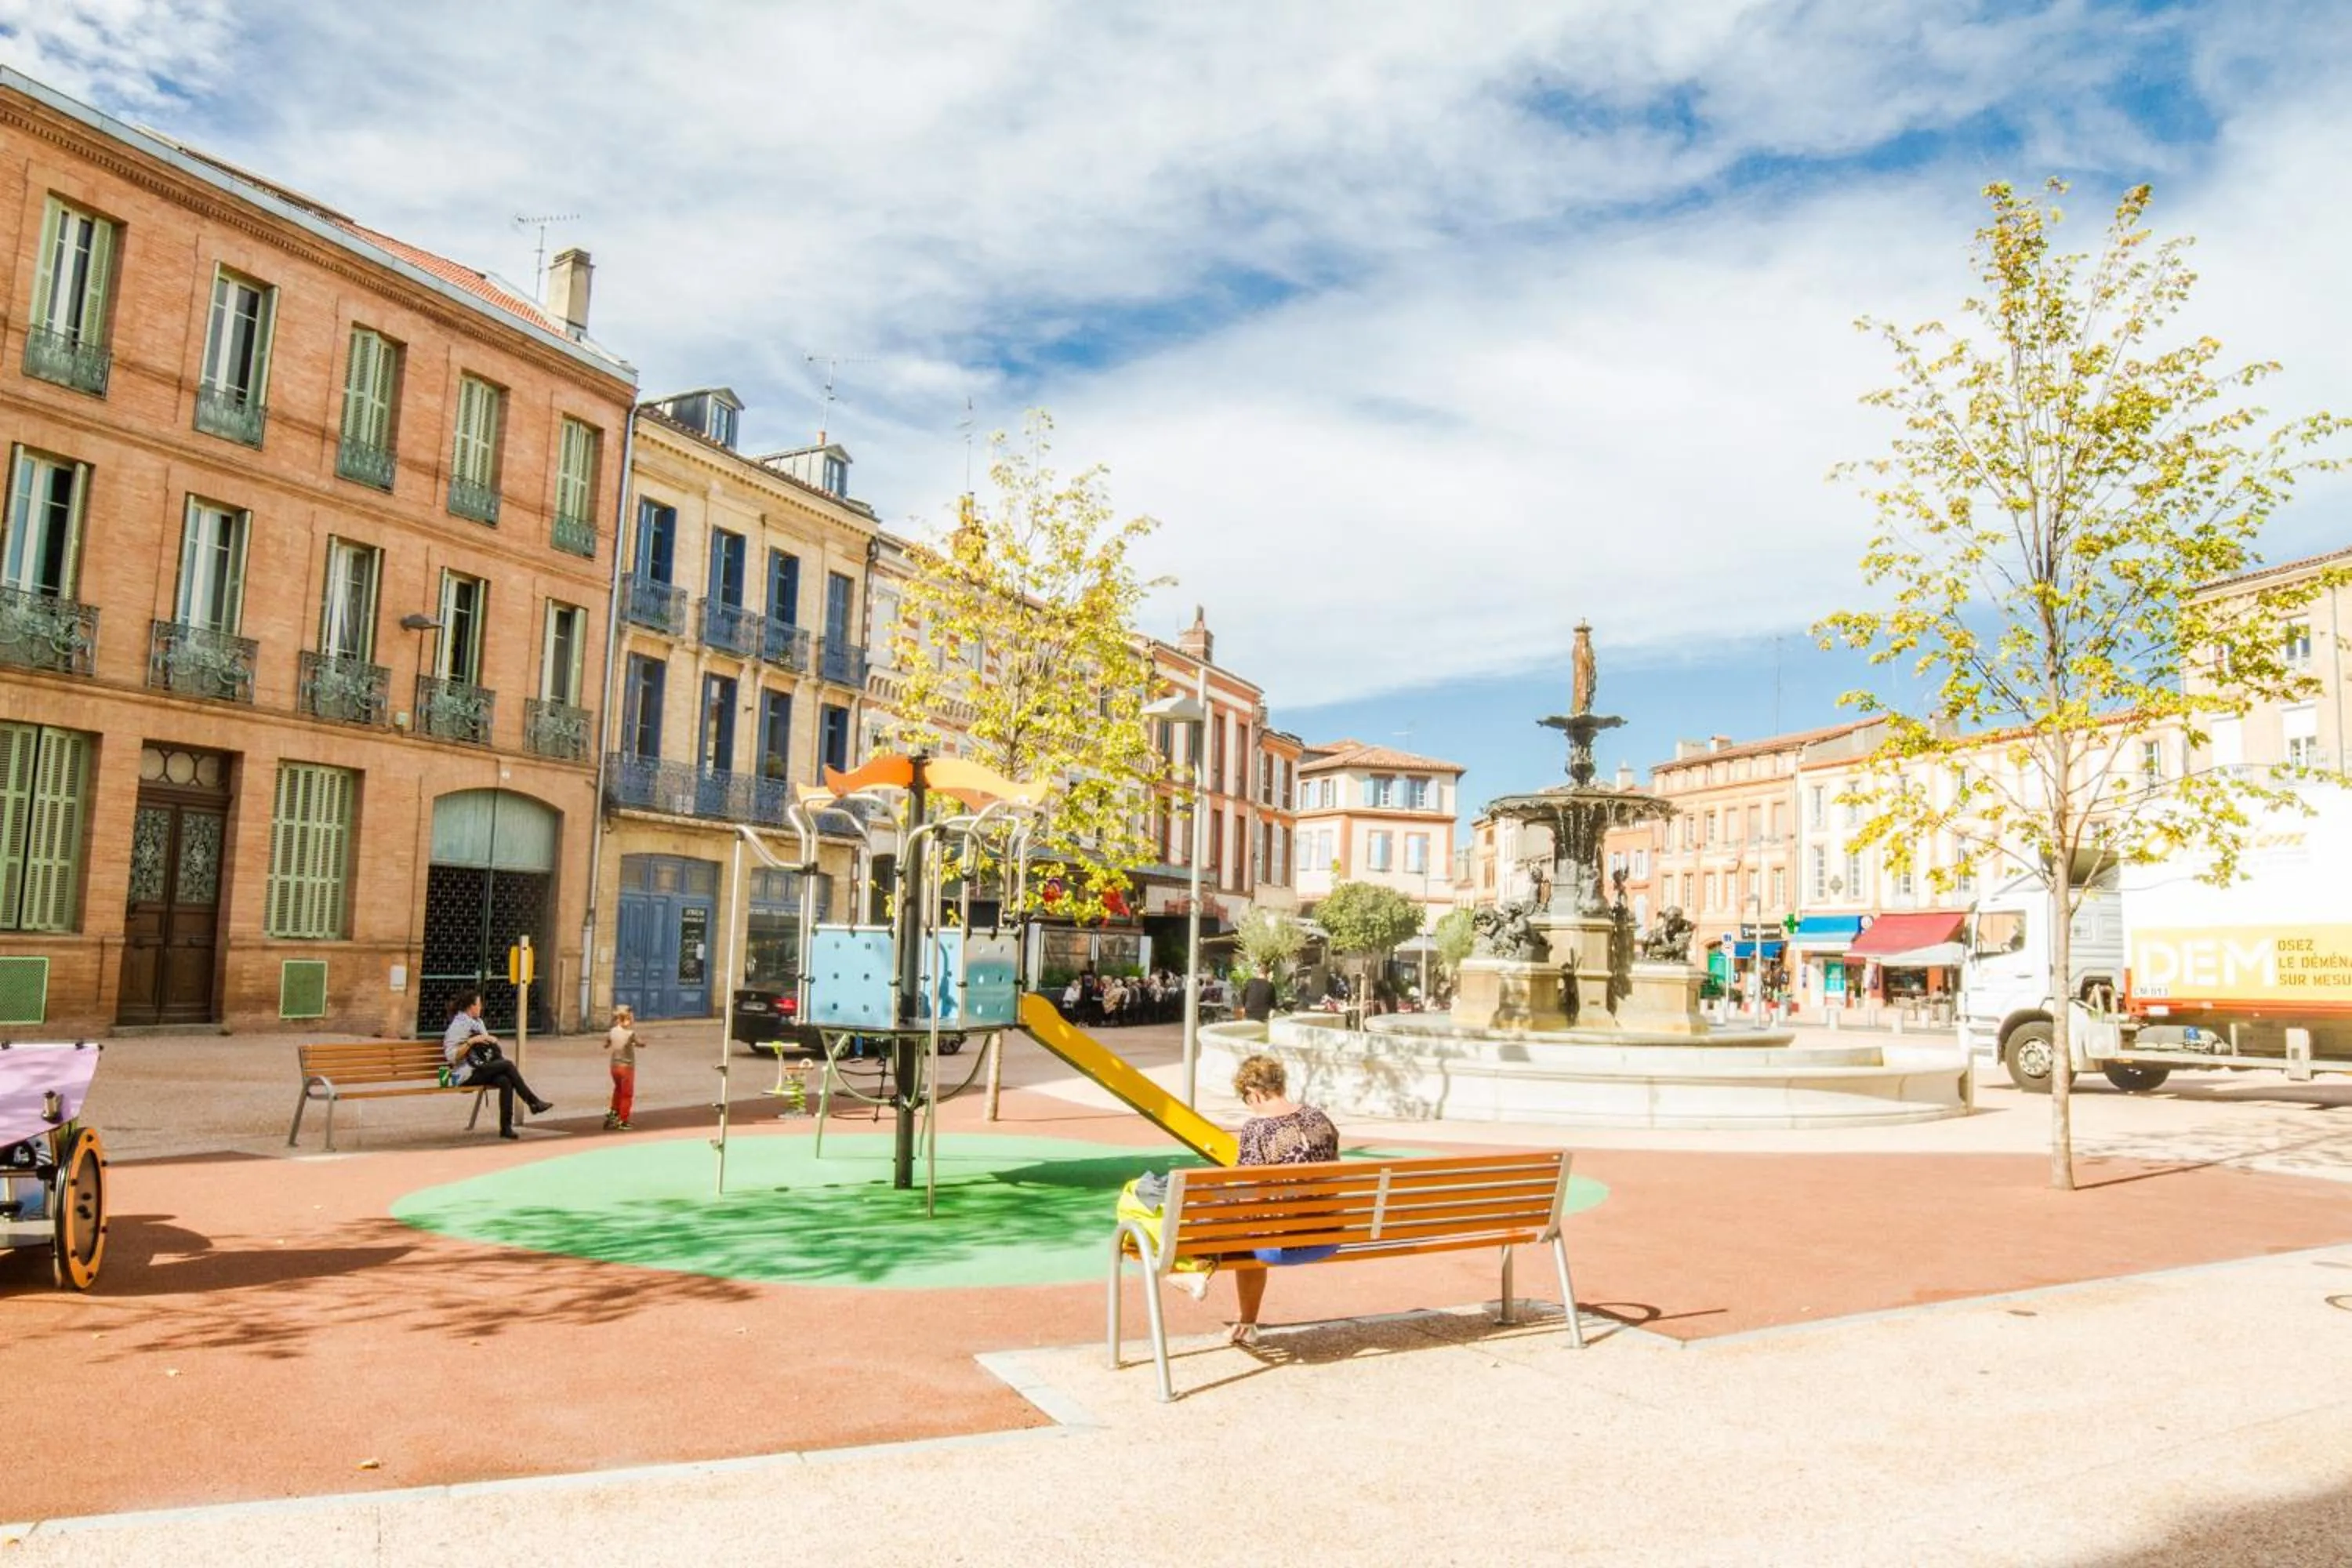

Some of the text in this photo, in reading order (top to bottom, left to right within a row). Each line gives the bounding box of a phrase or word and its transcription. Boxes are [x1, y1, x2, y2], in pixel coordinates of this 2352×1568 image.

[2278, 939, 2314, 952] OSEZ
[2140, 938, 2275, 986] DEM
[2278, 952, 2352, 968] LE DÉMÉN
[2279, 974, 2307, 985] SUR
